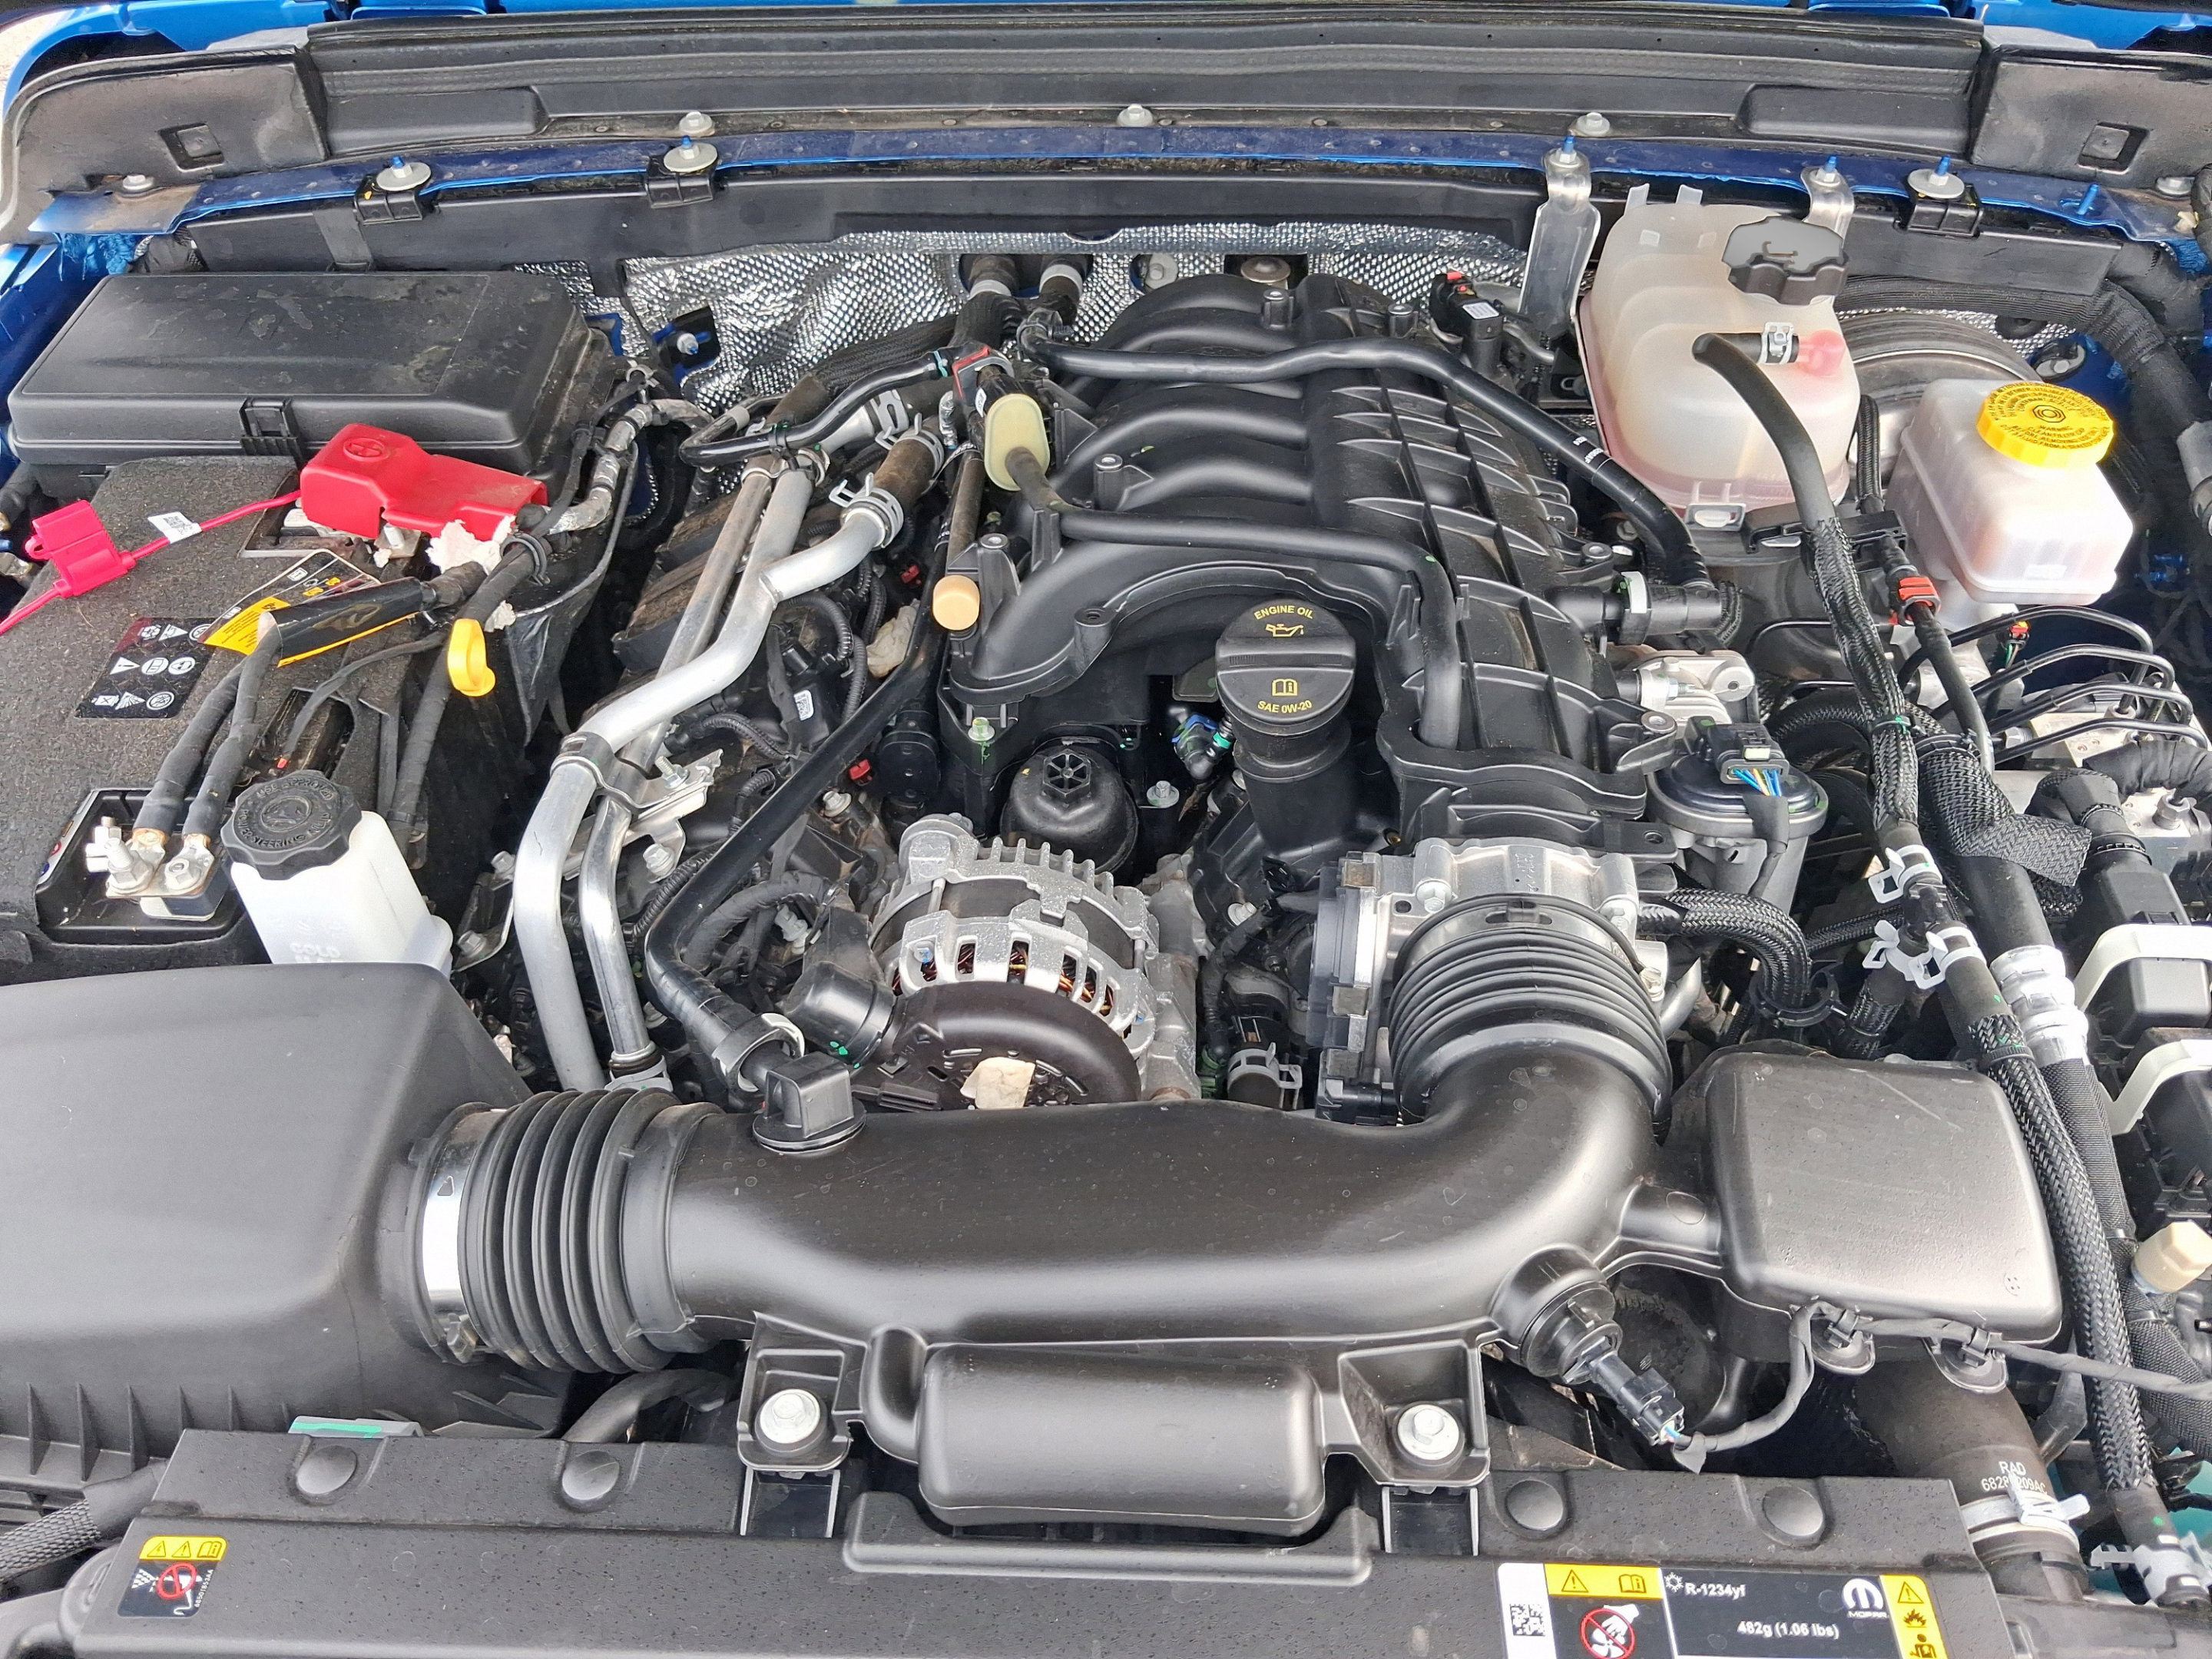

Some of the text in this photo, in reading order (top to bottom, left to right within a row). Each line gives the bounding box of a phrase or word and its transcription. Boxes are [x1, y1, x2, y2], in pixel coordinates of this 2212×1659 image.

[1253, 605, 1314, 620] ENGINE OIL
[1257, 700, 1313, 714] SAE 0W-20
[237, 809, 253, 839] POWER
[252, 833, 306, 849] STEERING
[1998, 1461, 2027, 1475] RAD
[1981, 1475, 2048, 1495] 6828209AC
[1684, 1583, 1747, 1600] R-1234yf
[1847, 1610, 1889, 1618] MOPAR
[1737, 1621, 1840, 1640] 482g (1.06 lbs)
